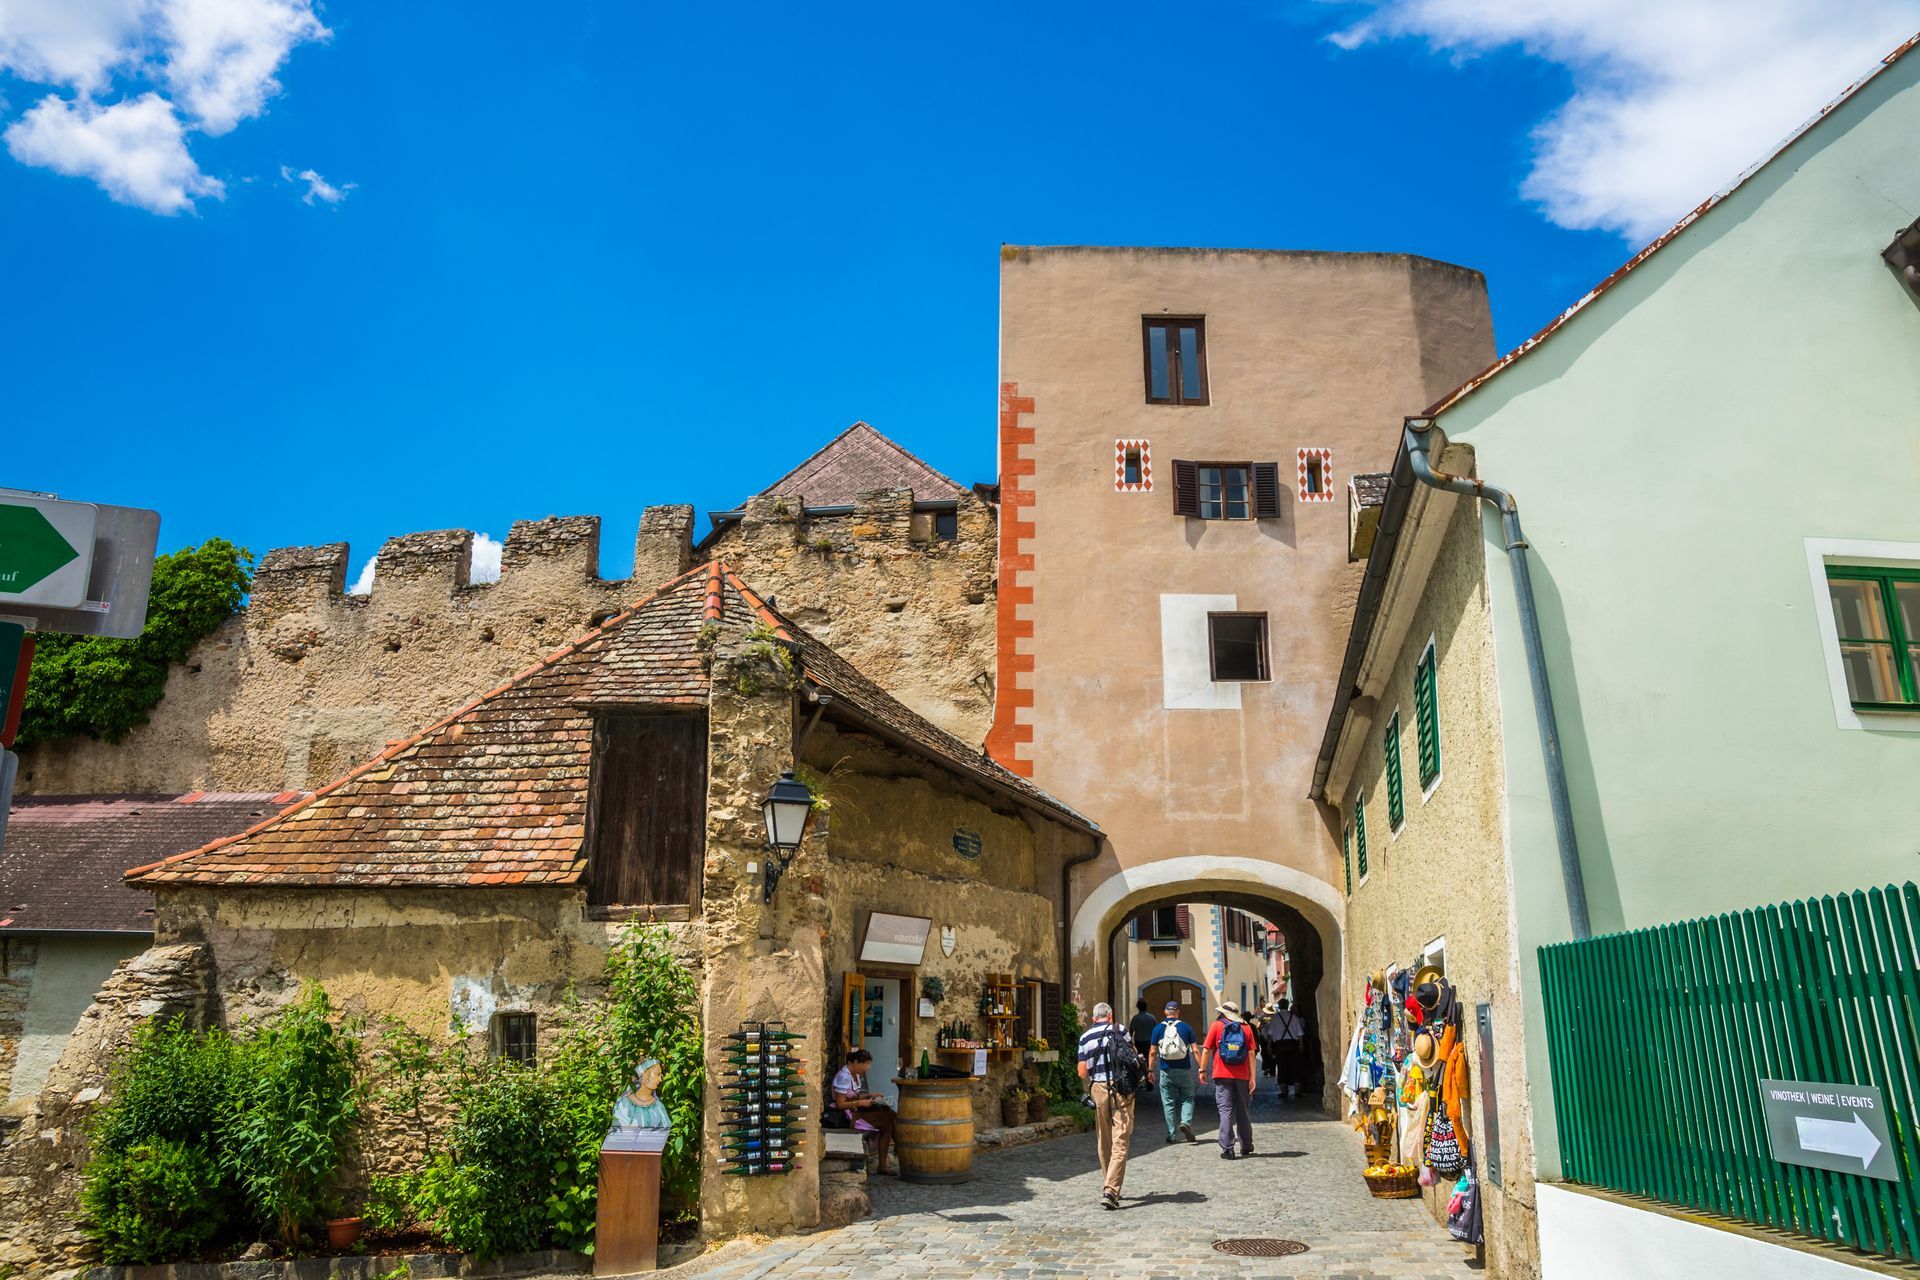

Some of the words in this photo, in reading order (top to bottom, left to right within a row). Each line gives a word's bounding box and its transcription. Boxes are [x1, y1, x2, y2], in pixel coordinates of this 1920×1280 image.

[0, 571, 20, 582] uf
[1770, 1090, 1806, 1103] VINOTHEK
[1810, 1093, 1836, 1106] WEINE
[1841, 1095, 1874, 1109] EVENTS
